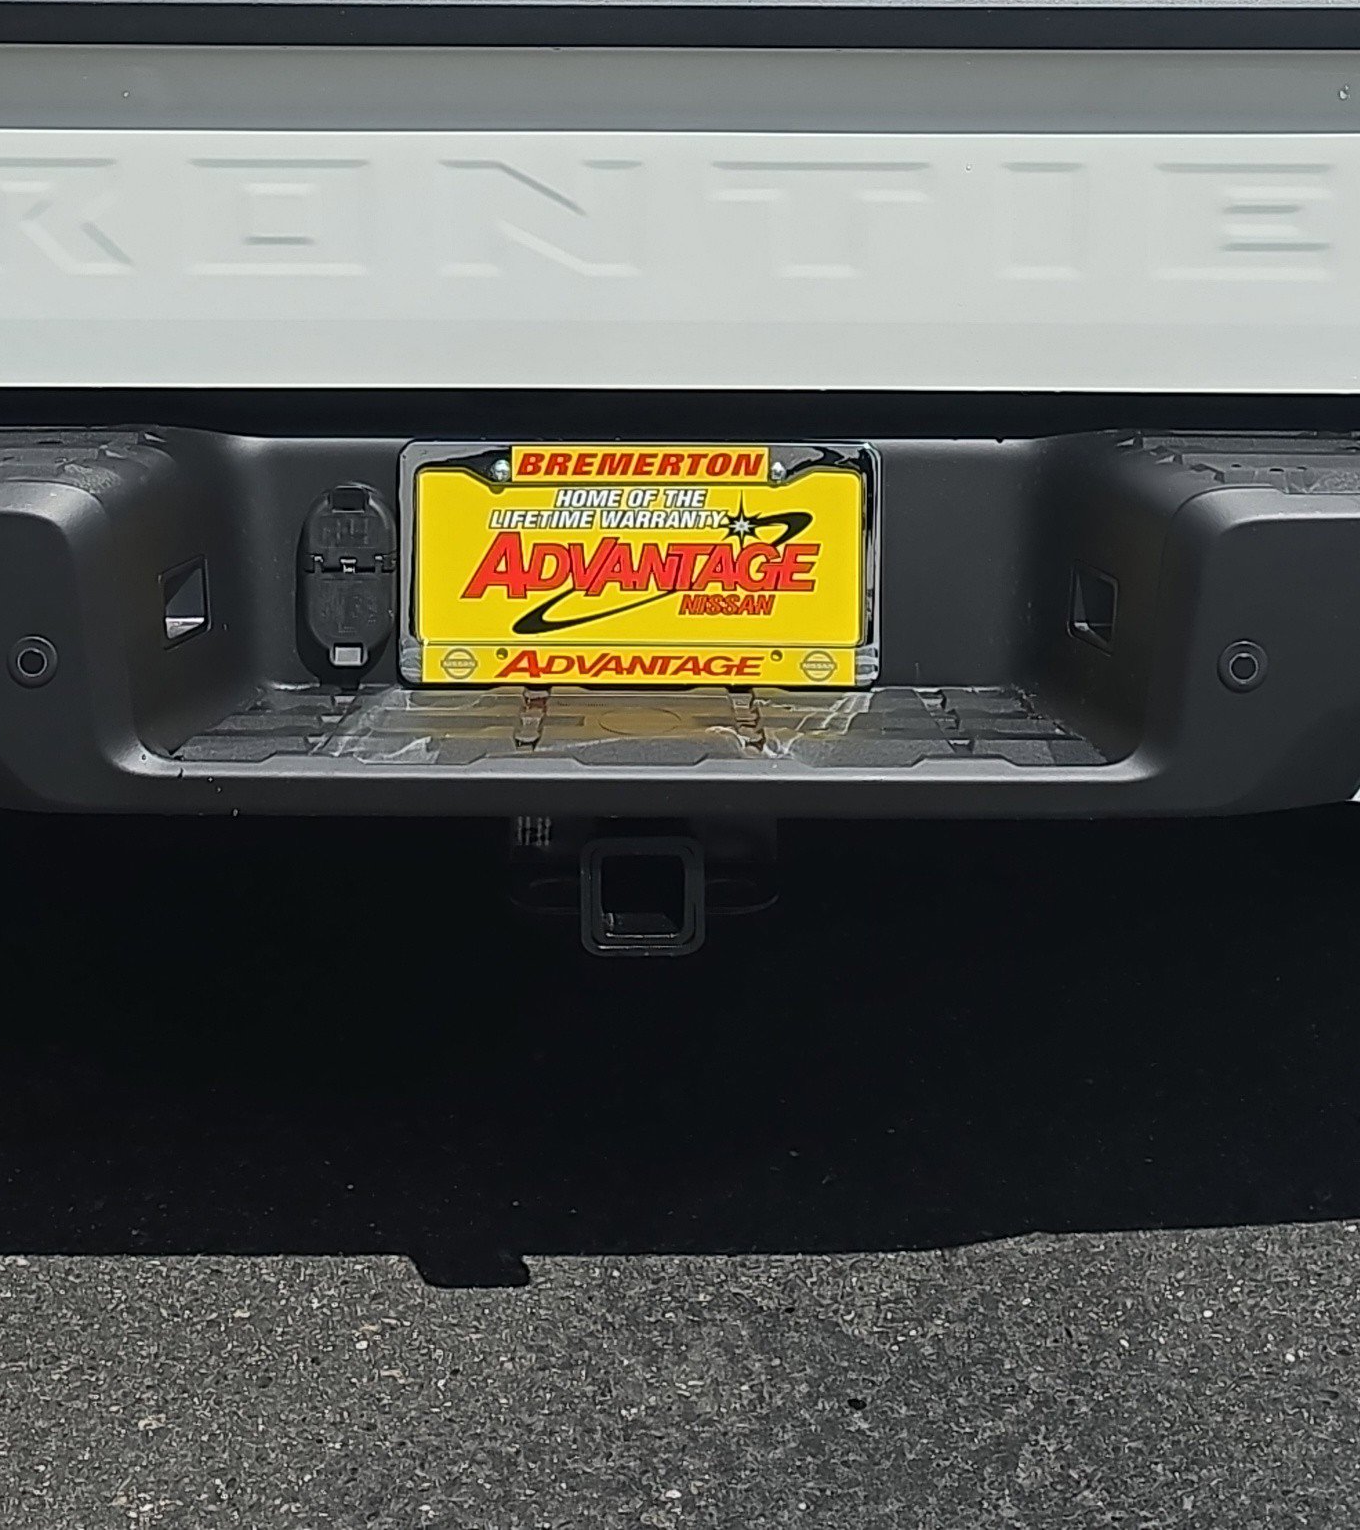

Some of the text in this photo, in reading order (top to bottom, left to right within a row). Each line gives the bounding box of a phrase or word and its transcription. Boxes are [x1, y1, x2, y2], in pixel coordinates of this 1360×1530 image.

[516, 453, 765, 477] BREMERTON
[554, 488, 708, 509] HOME OF THE
[489, 509, 727, 530] LIFETIME WARRANTY
[460, 531, 822, 599] ADVANTAGE
[677, 593, 776, 616] NISSAN
[495, 649, 765, 679] ADVANTAGE
